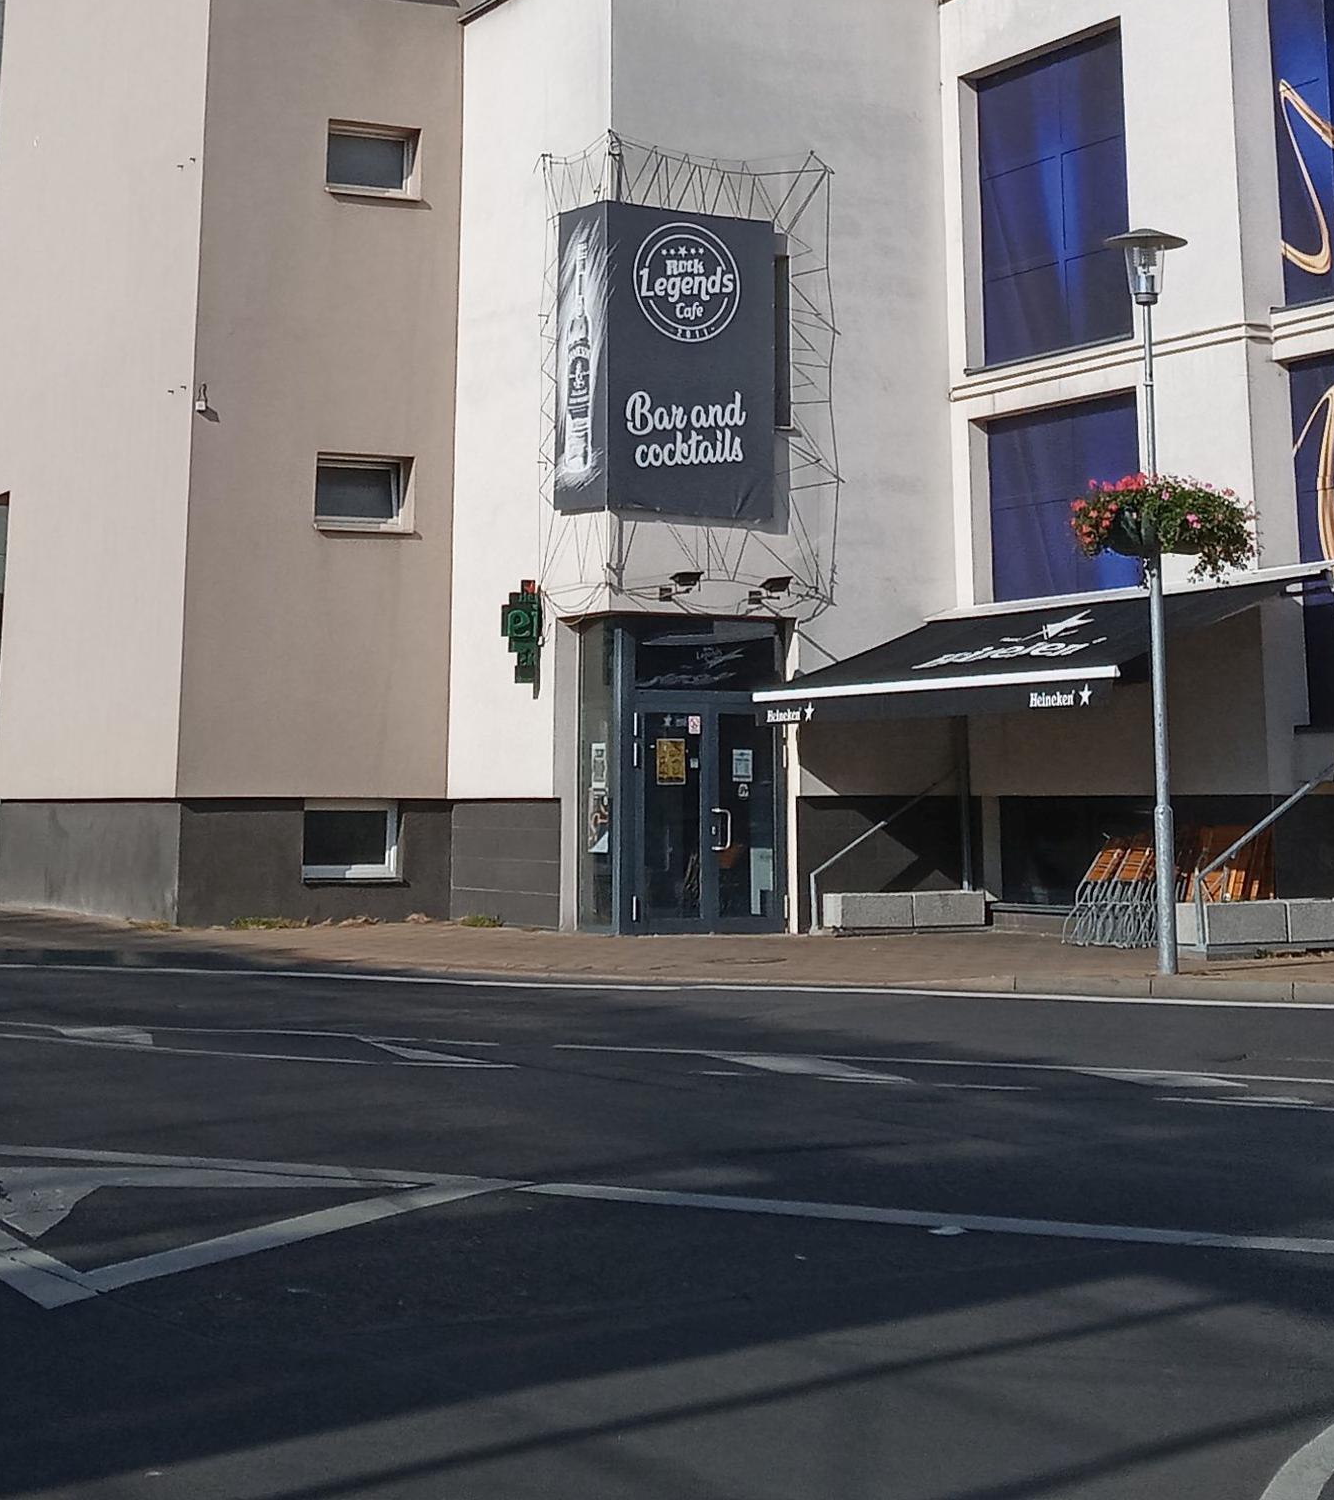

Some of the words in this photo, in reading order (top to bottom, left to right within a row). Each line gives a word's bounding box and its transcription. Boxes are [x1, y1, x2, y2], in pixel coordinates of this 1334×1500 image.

[665, 258, 705, 276] Rock
[639, 266, 734, 303] Legends
[675, 301, 704, 320] Cafe
[676, 328, 709, 339] 2011
[625, 390, 688, 436] Bar
[690, 391, 746, 428] and
[634, 429, 744, 468] cocktails
[1029, 691, 1075, 708] Heineken
[766, 707, 802, 724] Heineken
